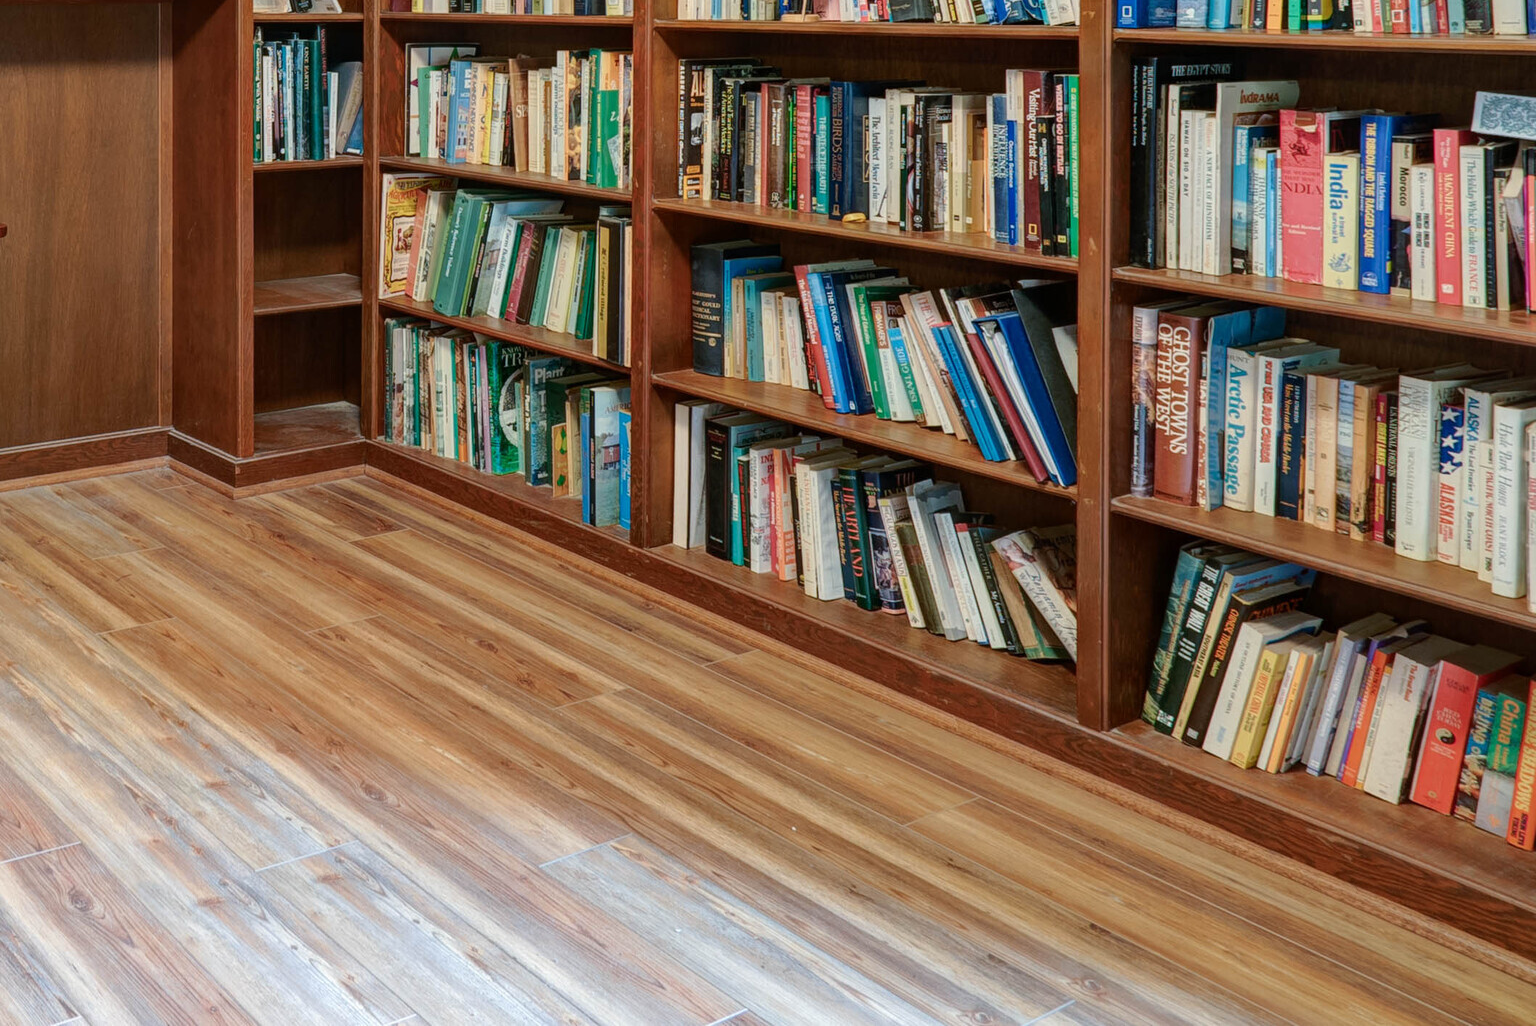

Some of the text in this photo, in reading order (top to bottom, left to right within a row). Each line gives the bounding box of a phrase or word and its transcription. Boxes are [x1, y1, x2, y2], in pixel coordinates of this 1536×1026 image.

[1171, 63, 1232, 77] THE EGYPT STORY
[832, 119, 842, 153] BIRDS
[1056, 112, 1063, 122] TO
[1056, 123, 1063, 134] GO
[1056, 135, 1063, 144] IN
[870, 116, 880, 199] The Architect Meyer Levin
[1056, 145, 1064, 175] BRITAIN
[1206, 191, 1212, 200] OF
[1258, 176, 1266, 219] THAILAND
[1329, 163, 1348, 210] India
[1364, 123, 1376, 258] THE RIBBON AND THE RAGGED SQUARE
[1399, 167, 1409, 207] Morocco
[1205, 202, 1213, 240] HINDUISM
[1443, 173, 1456, 258] MAGNIFICENT CHINA
[497, 228, 512, 279] Farm Buildings
[874, 306, 886, 347] FROMMER'S
[1156, 323, 1172, 435] OF THE WEST
[1168, 326, 1191, 454] GHOST TOWNS
[1224, 364, 1248, 495] Arctic Passage
[1260, 387, 1273, 463] USA AND CANADA
[1467, 396, 1480, 442] ALASKA
[1376, 422, 1387, 466] GREAT LAKES
[1498, 423, 1513, 507] Hyde Park Houses
[1467, 468, 1475, 492] Frontier
[1439, 483, 1455, 524] ALASKA
[842, 487, 864, 577] HEARTLAND
[1464, 511, 1474, 551] Bryan Cooper
[972, 531, 992, 580] WILLA CATHER
[1186, 565, 1220, 633] THE GREAT WALL
[1471, 692, 1495, 745] BEIJING
[1496, 700, 1520, 745] China
[1514, 743, 1536, 813] SHADOWS
